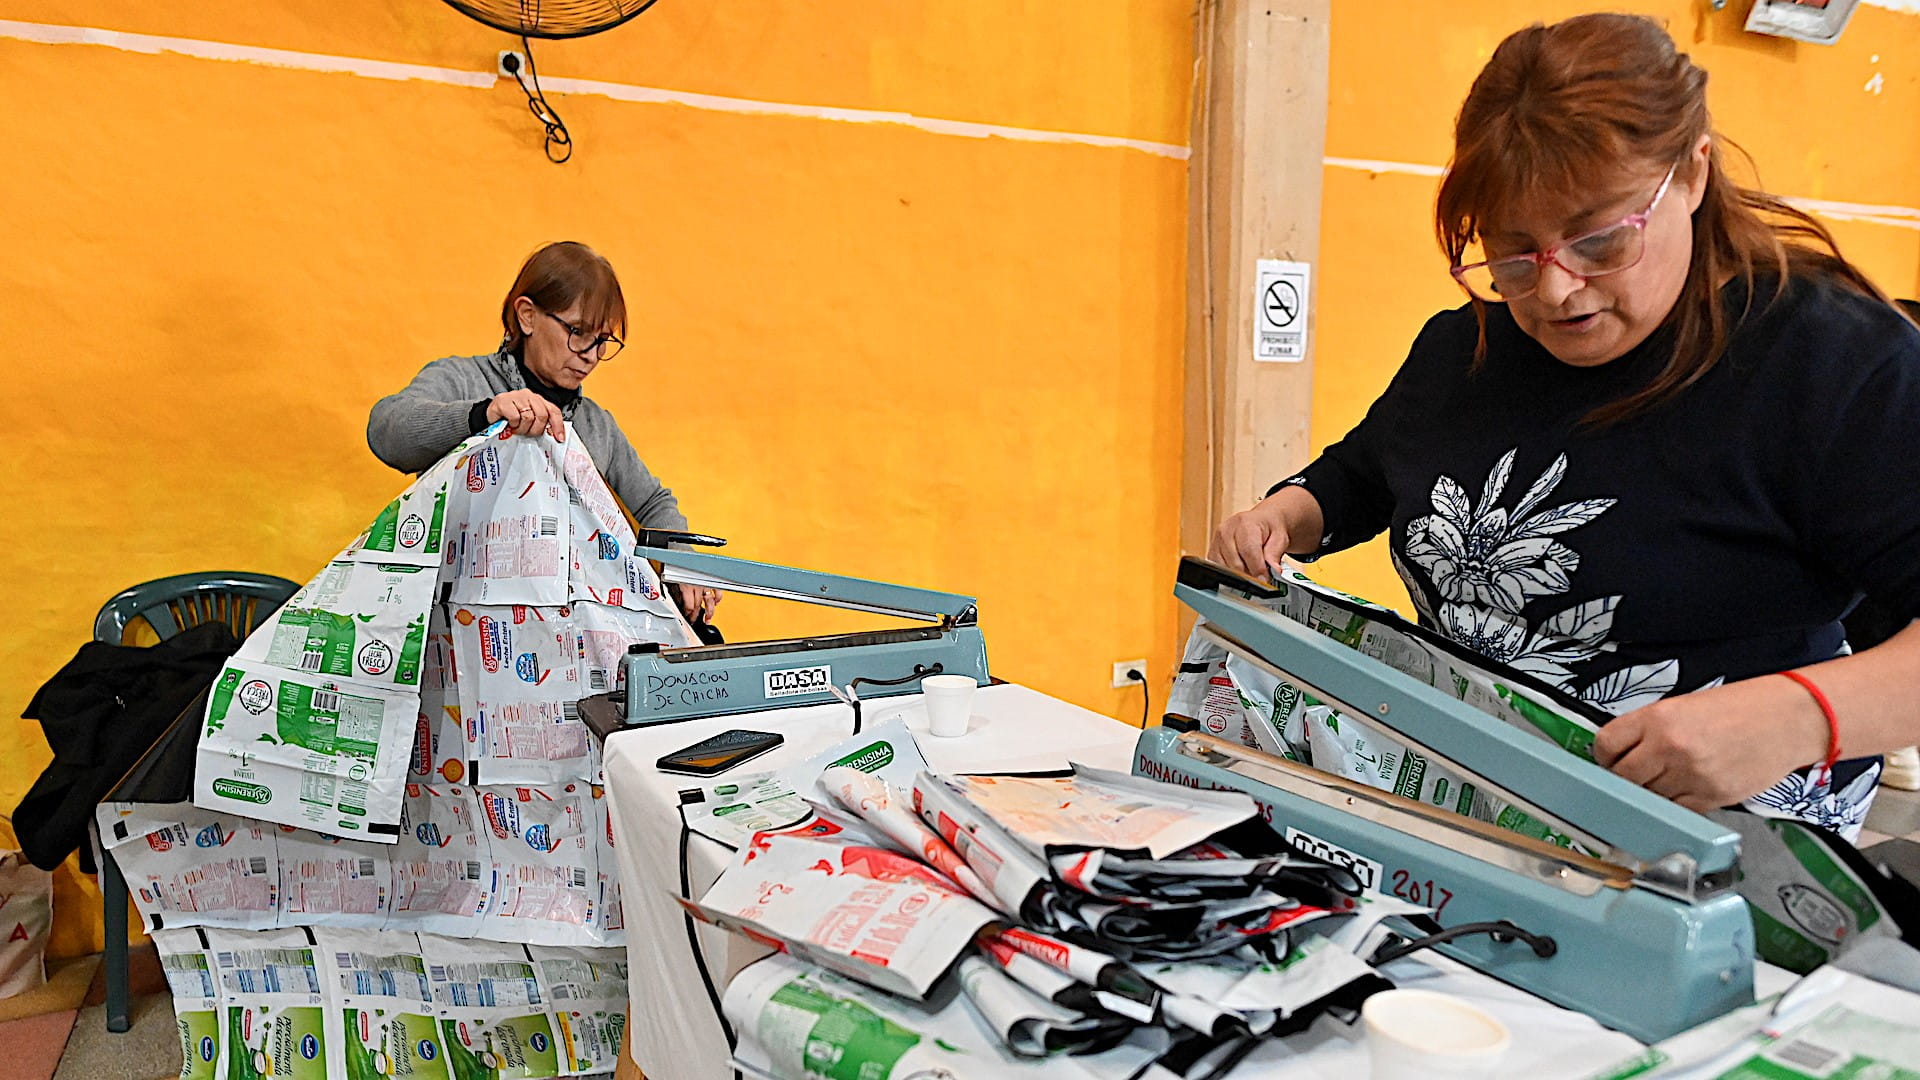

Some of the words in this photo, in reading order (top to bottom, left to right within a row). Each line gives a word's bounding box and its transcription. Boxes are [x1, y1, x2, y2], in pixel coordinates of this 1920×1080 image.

[1268, 346, 1293, 355] FUMAR
[648, 670, 729, 693] DONACION
[769, 668, 827, 690] DASA
[654, 694, 674, 711] DE
[1139, 754, 1199, 789] DONACION
[1392, 869, 1454, 922] 2017
